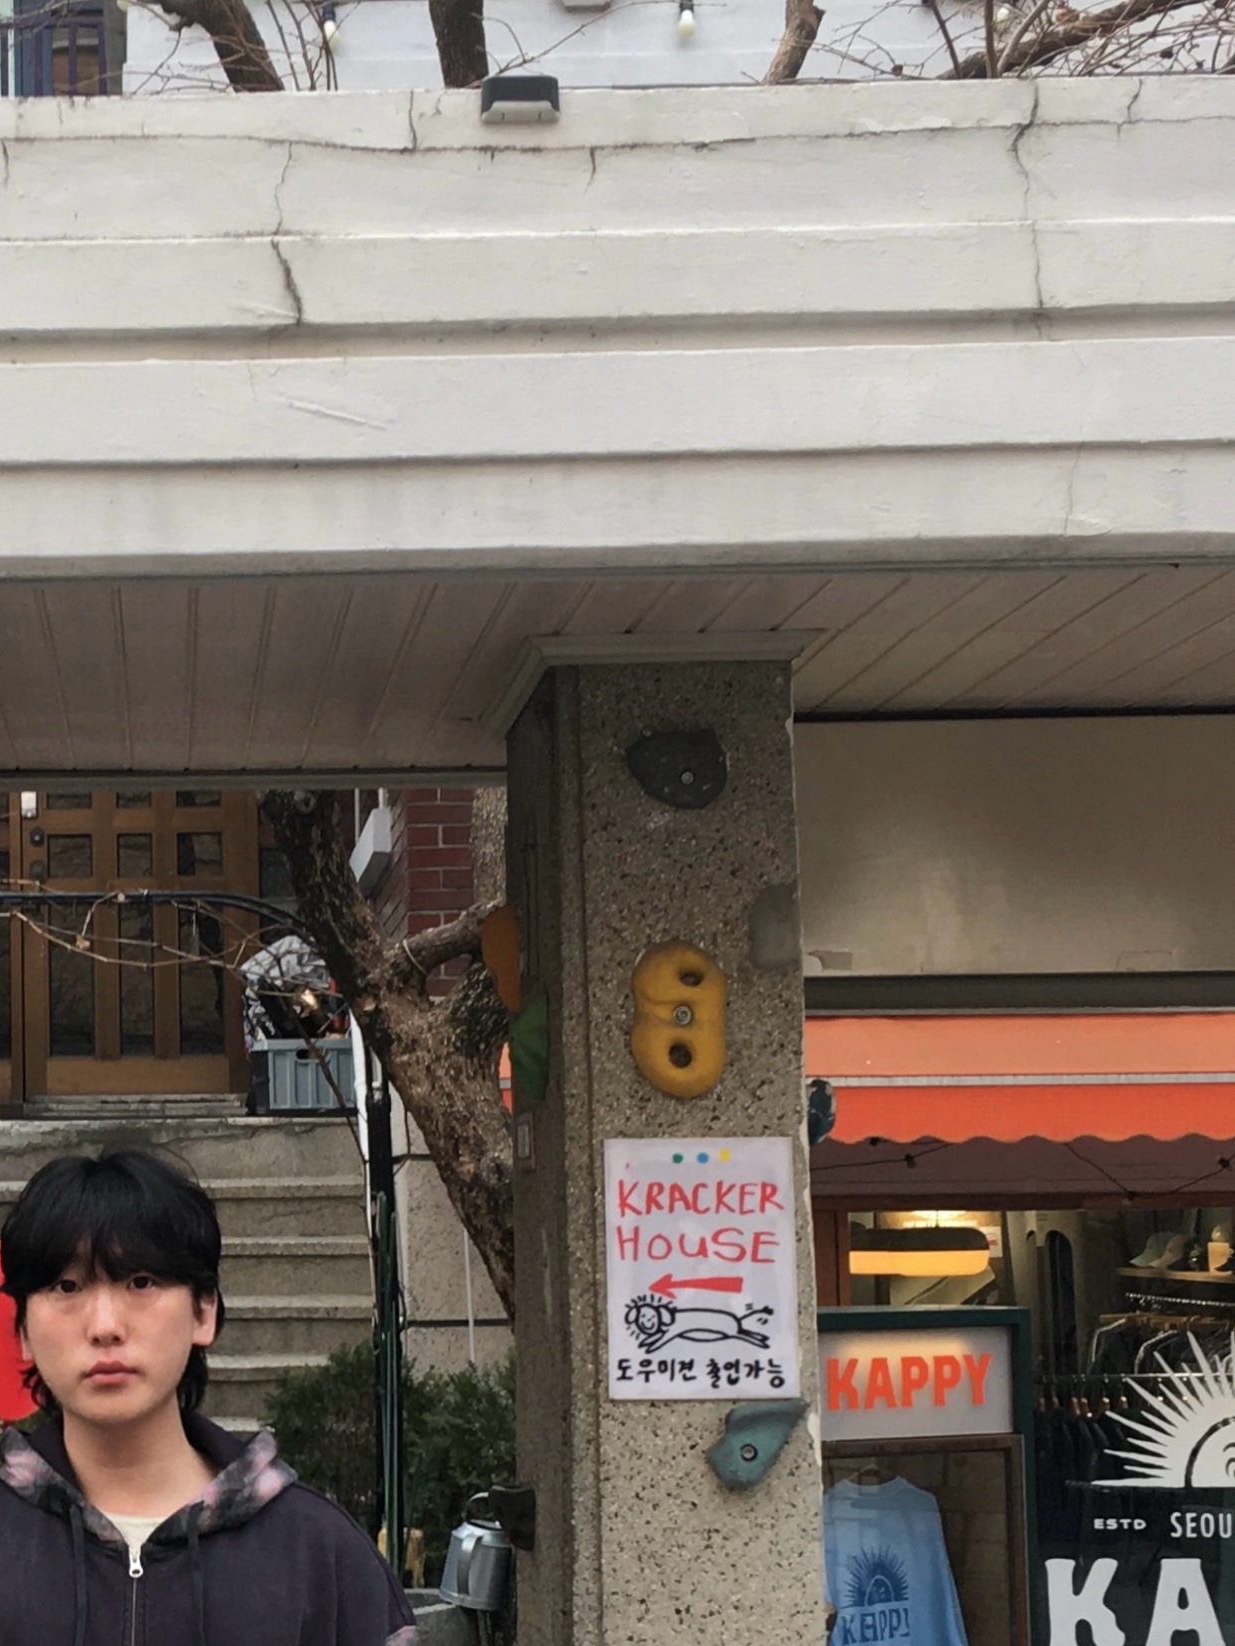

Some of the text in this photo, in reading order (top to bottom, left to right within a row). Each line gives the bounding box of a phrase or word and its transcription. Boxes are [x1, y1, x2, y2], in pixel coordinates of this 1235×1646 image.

[617, 1179, 784, 1218] KRACKER
[616, 1358, 698, 1383] 도우미견
[826, 1352, 992, 1412] KAPPY
[1093, 1511, 1232, 1538] ESTD SEOU
